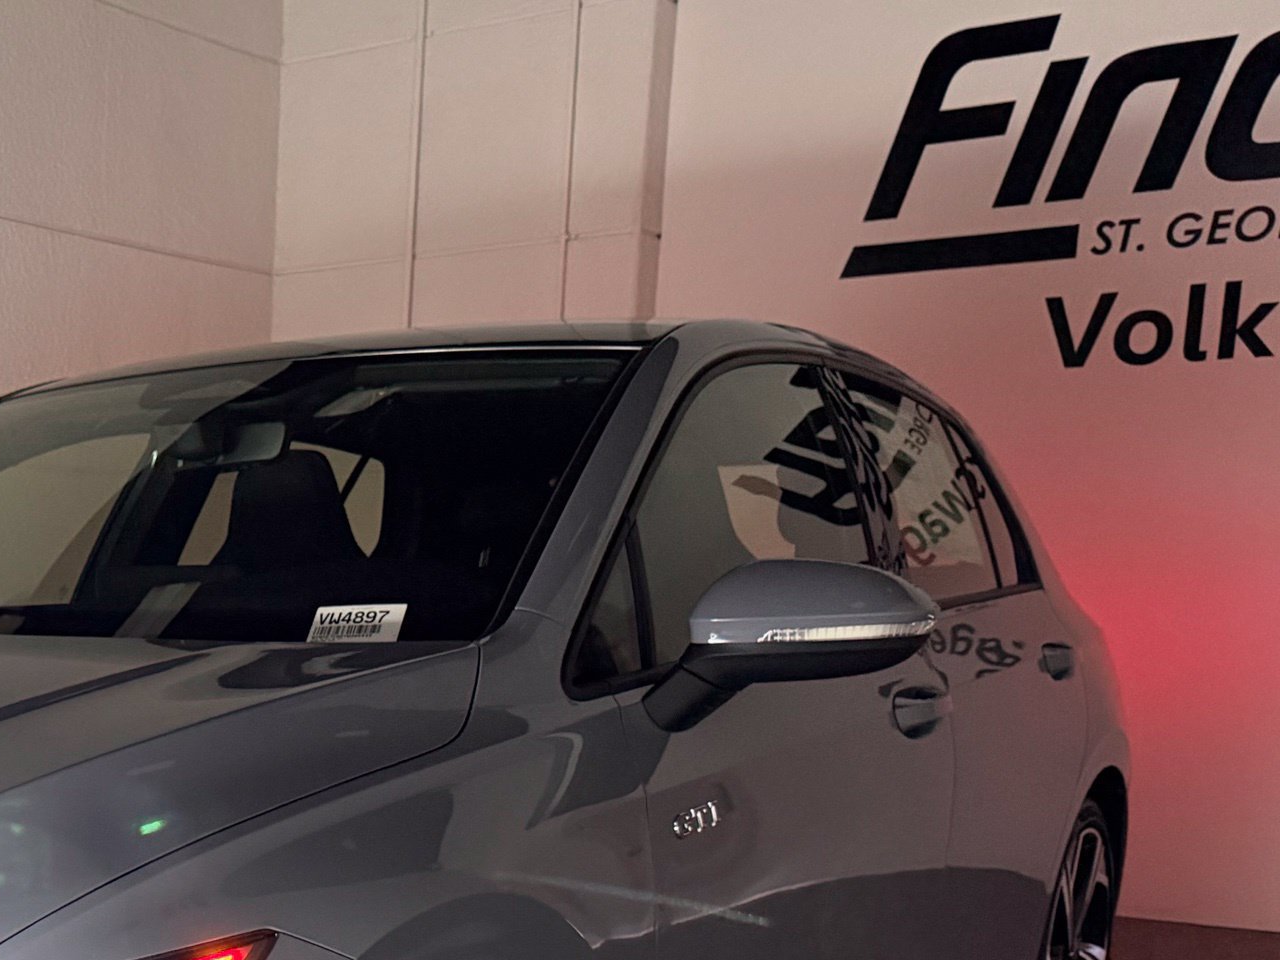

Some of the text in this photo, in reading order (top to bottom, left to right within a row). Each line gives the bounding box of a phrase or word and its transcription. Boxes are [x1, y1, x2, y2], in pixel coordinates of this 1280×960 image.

[1090, 205, 1280, 256] ST. GEO
[1045, 280, 1280, 368] Volk
[319, 610, 390, 625] VW4897
[673, 800, 721, 838] GTI
